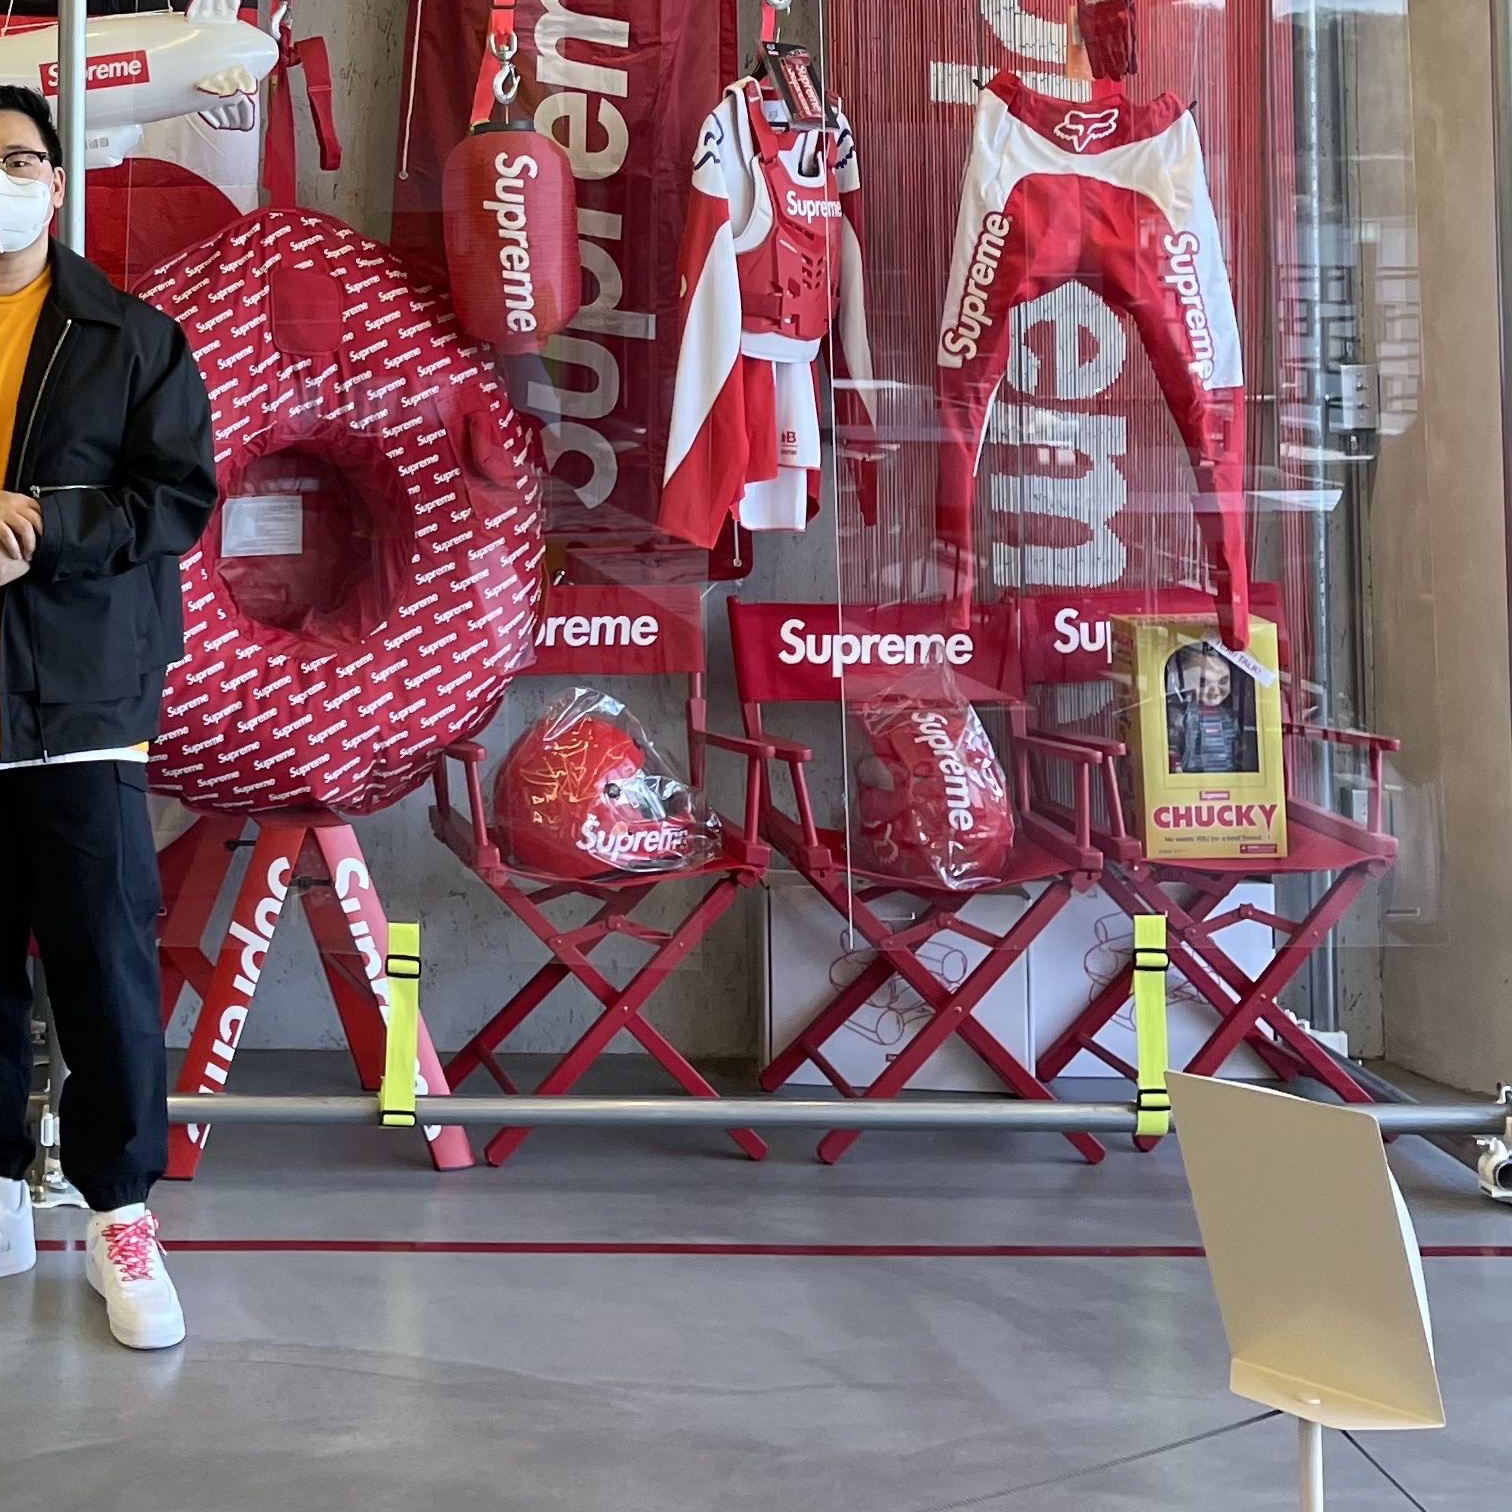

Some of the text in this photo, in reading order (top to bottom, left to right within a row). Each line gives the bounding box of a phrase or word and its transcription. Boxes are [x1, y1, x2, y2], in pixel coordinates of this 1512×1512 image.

[48, 59, 142, 87] Sreme
[786, 190, 843, 224] Supreme
[260, 225, 291, 247] Supreme
[290, 235, 324, 251] Supreme
[482, 152, 538, 336] Supreme
[220, 250, 254, 274] Supreme
[252, 253, 282, 278] Supreme
[172, 278, 210, 303] Supreme
[208, 279, 245, 303] Supreme
[943, 211, 1011, 361] Supreme
[196, 309, 233, 333] Supreme
[365, 310, 401, 331] Supreme
[1164, 231, 1215, 387] Supreme
[231, 313, 267, 338] Supreme
[398, 320, 432, 339] Supreme
[217, 346, 253, 370] Supreme
[349, 339, 388, 362] Supreme
[384, 347, 421, 369] Supreme
[417, 357, 451, 377] Supreme
[334, 370, 372, 393] Supreme
[367, 377, 406, 400] Supreme
[233, 383, 268, 408] Supreme
[261, 388, 294, 413] Supreme
[401, 385, 439, 408] Supreme
[215, 416, 250, 440] Supreme
[350, 408, 388, 430] Supreme
[382, 416, 423, 438] Supreme
[398, 454, 439, 476] Supreme
[415, 492, 456, 515] Supreme
[484, 507, 517, 529] Supreme
[432, 531, 473, 553] Supreme
[468, 537, 505, 560] Supreme
[415, 562, 455, 585] Supreme
[450, 568, 489, 592] Supreme
[484, 574, 517, 599] Supreme
[399, 594, 438, 618] Supreme
[434, 600, 473, 624] Supreme
[467, 607, 503, 631] Supreme
[203, 629, 239, 652] Supreme
[384, 626, 422, 651] Supreme
[419, 633, 457, 657] Supreme
[778, 619, 974, 678] Supreme
[452, 639, 488, 663] Supreme
[186, 661, 225, 685] Supreme
[336, 653, 374, 678] Supreme
[371, 659, 408, 684] Supreme
[404, 665, 442, 690] Supreme
[220, 668, 258, 692] Supreme
[253, 675, 292, 700] Supreme
[437, 671, 472, 696] Supreme
[167, 694, 209, 717] Supreme
[288, 681, 326, 706] Supreme
[323, 686, 361, 712] Supreme
[358, 692, 393, 717] Supreme
[202, 701, 242, 725] Supreme
[237, 708, 277, 733] Supreme
[389, 698, 426, 723] Supreme
[420, 704, 456, 729] Supreme
[273, 714, 313, 739] Supreme
[308, 719, 347, 745] Supreme
[342, 725, 380, 750] Supreme
[182, 734, 224, 755] Supreme
[218, 741, 260, 763] Supreme
[162, 763, 203, 778] Supreme
[254, 748, 295, 770] Supreme
[289, 753, 330, 778] Supreme
[324, 757, 361, 783] Supreme
[197, 771, 240, 787] Supreme
[909, 711, 974, 832] Supreme
[233, 778, 275, 794] Supreme
[1153, 804, 1278, 830] CHUCKY
